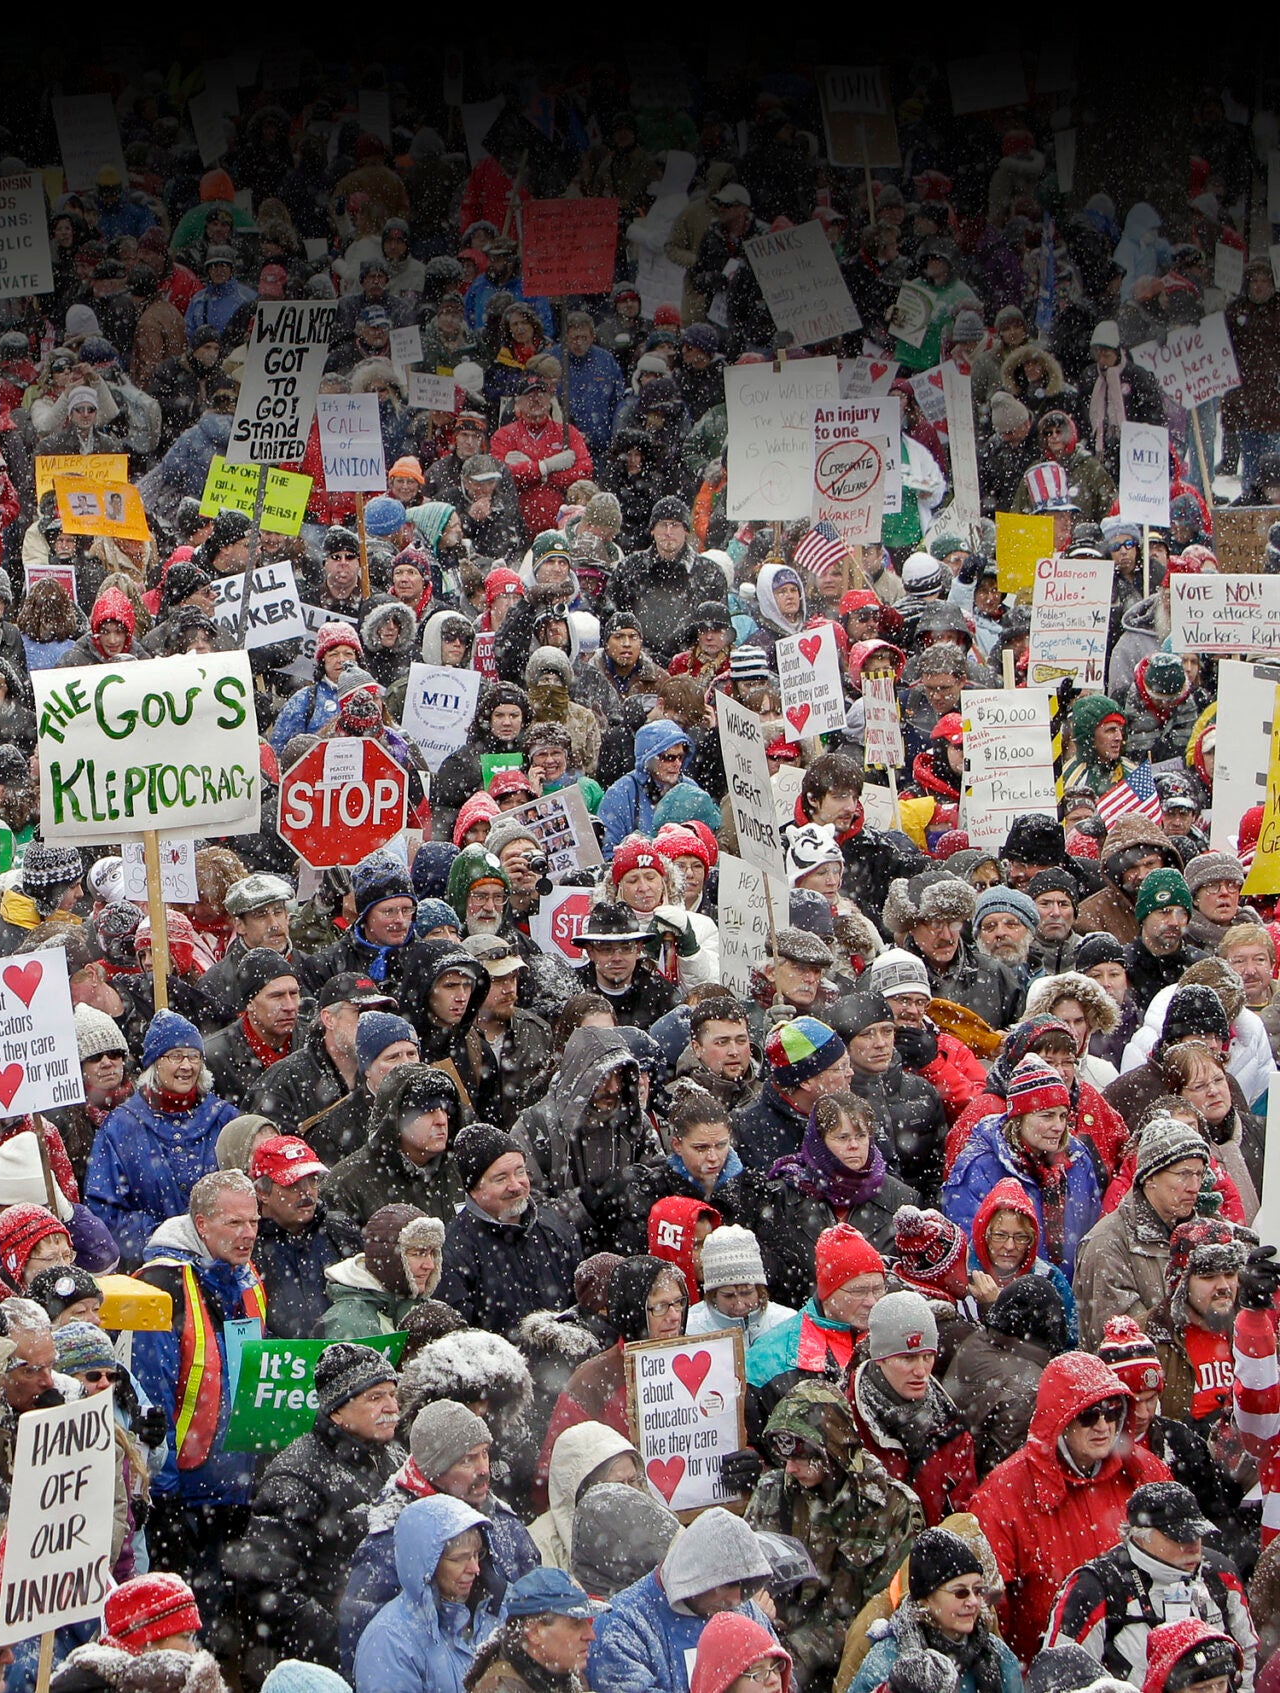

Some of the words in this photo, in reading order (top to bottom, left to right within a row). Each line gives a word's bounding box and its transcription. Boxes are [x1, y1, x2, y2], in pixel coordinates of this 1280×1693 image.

[747, 230, 804, 258] THANKS
[256, 306, 338, 344] WALKER
[264, 346, 310, 375] GOT
[1181, 353, 1213, 377] here
[268, 377, 297, 397] TO
[256, 396, 300, 421] GO!
[321, 400, 339, 412] It's
[347, 399, 362, 411] the
[814, 408, 834, 423] An
[838, 405, 880, 424] injury
[327, 416, 371, 435] CALL
[814, 424, 831, 440] to
[833, 426, 859, 438] one
[339, 437, 354, 450] of
[1132, 449, 1159, 464] MTI
[221, 463, 238, 475] LAY
[270, 474, 290, 488] THE
[324, 456, 381, 478] UNION
[215, 480, 237, 493] BILL
[831, 480, 869, 497] WELFARE
[210, 493, 227, 503] MY
[235, 499, 297, 522] TEAHERS!
[1127, 491, 1165, 505] Solidarity!
[1038, 560, 1097, 580] Classroom
[1045, 581, 1086, 601] Rules:
[1175, 583, 1213, 602] VOTE
[1225, 581, 1263, 603] NO!!
[1036, 607, 1067, 620] Problem
[1041, 618, 1065, 630] Solving
[1066, 615, 1086, 628] Skills
[1186, 606, 1204, 620] to
[1213, 606, 1262, 620] attacks
[1032, 632, 1082, 650] Cooperative
[1182, 625, 1241, 644] Worker's
[778, 640, 795, 657] Care
[1041, 649, 1058, 661] Play
[780, 656, 800, 673] about
[782, 669, 816, 690] educators
[421, 690, 460, 709] MTI
[784, 691, 797, 706] like
[798, 688, 813, 704] they
[814, 684, 830, 698] care
[964, 695, 999, 711] Income
[39, 679, 91, 744] THE
[811, 700, 823, 716] for
[823, 697, 839, 714] your
[976, 706, 1036, 726] $50,000
[826, 712, 844, 729] child
[965, 730, 991, 743] Health
[735, 753, 753, 775] THE
[984, 746, 1034, 762] $18,000
[330, 765, 356, 773] PEACEFUL
[50, 758, 255, 825] KLEPTOCRACY
[732, 774, 762, 808] GREAT
[990, 779, 1056, 803] Priceless
[285, 779, 400, 830] STOP
[737, 808, 778, 849] DIVIDER
[970, 813, 993, 827] Scott
[972, 822, 1004, 838] Walker
[738, 872, 760, 892] HEY
[723, 906, 744, 926] I'LL
[721, 937, 738, 956] YOU
[741, 942, 749, 958] A
[3, 1040, 28, 1062] they
[31, 1035, 56, 1057] care
[25, 1062, 42, 1083] for
[45, 1057, 69, 1081] your
[52, 1077, 81, 1103] child
[237, 1327, 246, 1336] M
[258, 1351, 306, 1380] It's
[641, 1355, 665, 1378] Care
[253, 1382, 320, 1410] Free
[643, 1381, 674, 1405] about
[644, 1405, 699, 1431] educators
[31, 1404, 111, 1467] HANDS
[645, 1434, 666, 1457] like
[668, 1430, 693, 1456] they
[694, 1429, 718, 1450] care
[687, 1455, 702, 1477] for
[40, 1464, 92, 1511] OFF
[30, 1513, 90, 1559] OUR
[4, 1554, 108, 1627] UNIONS
